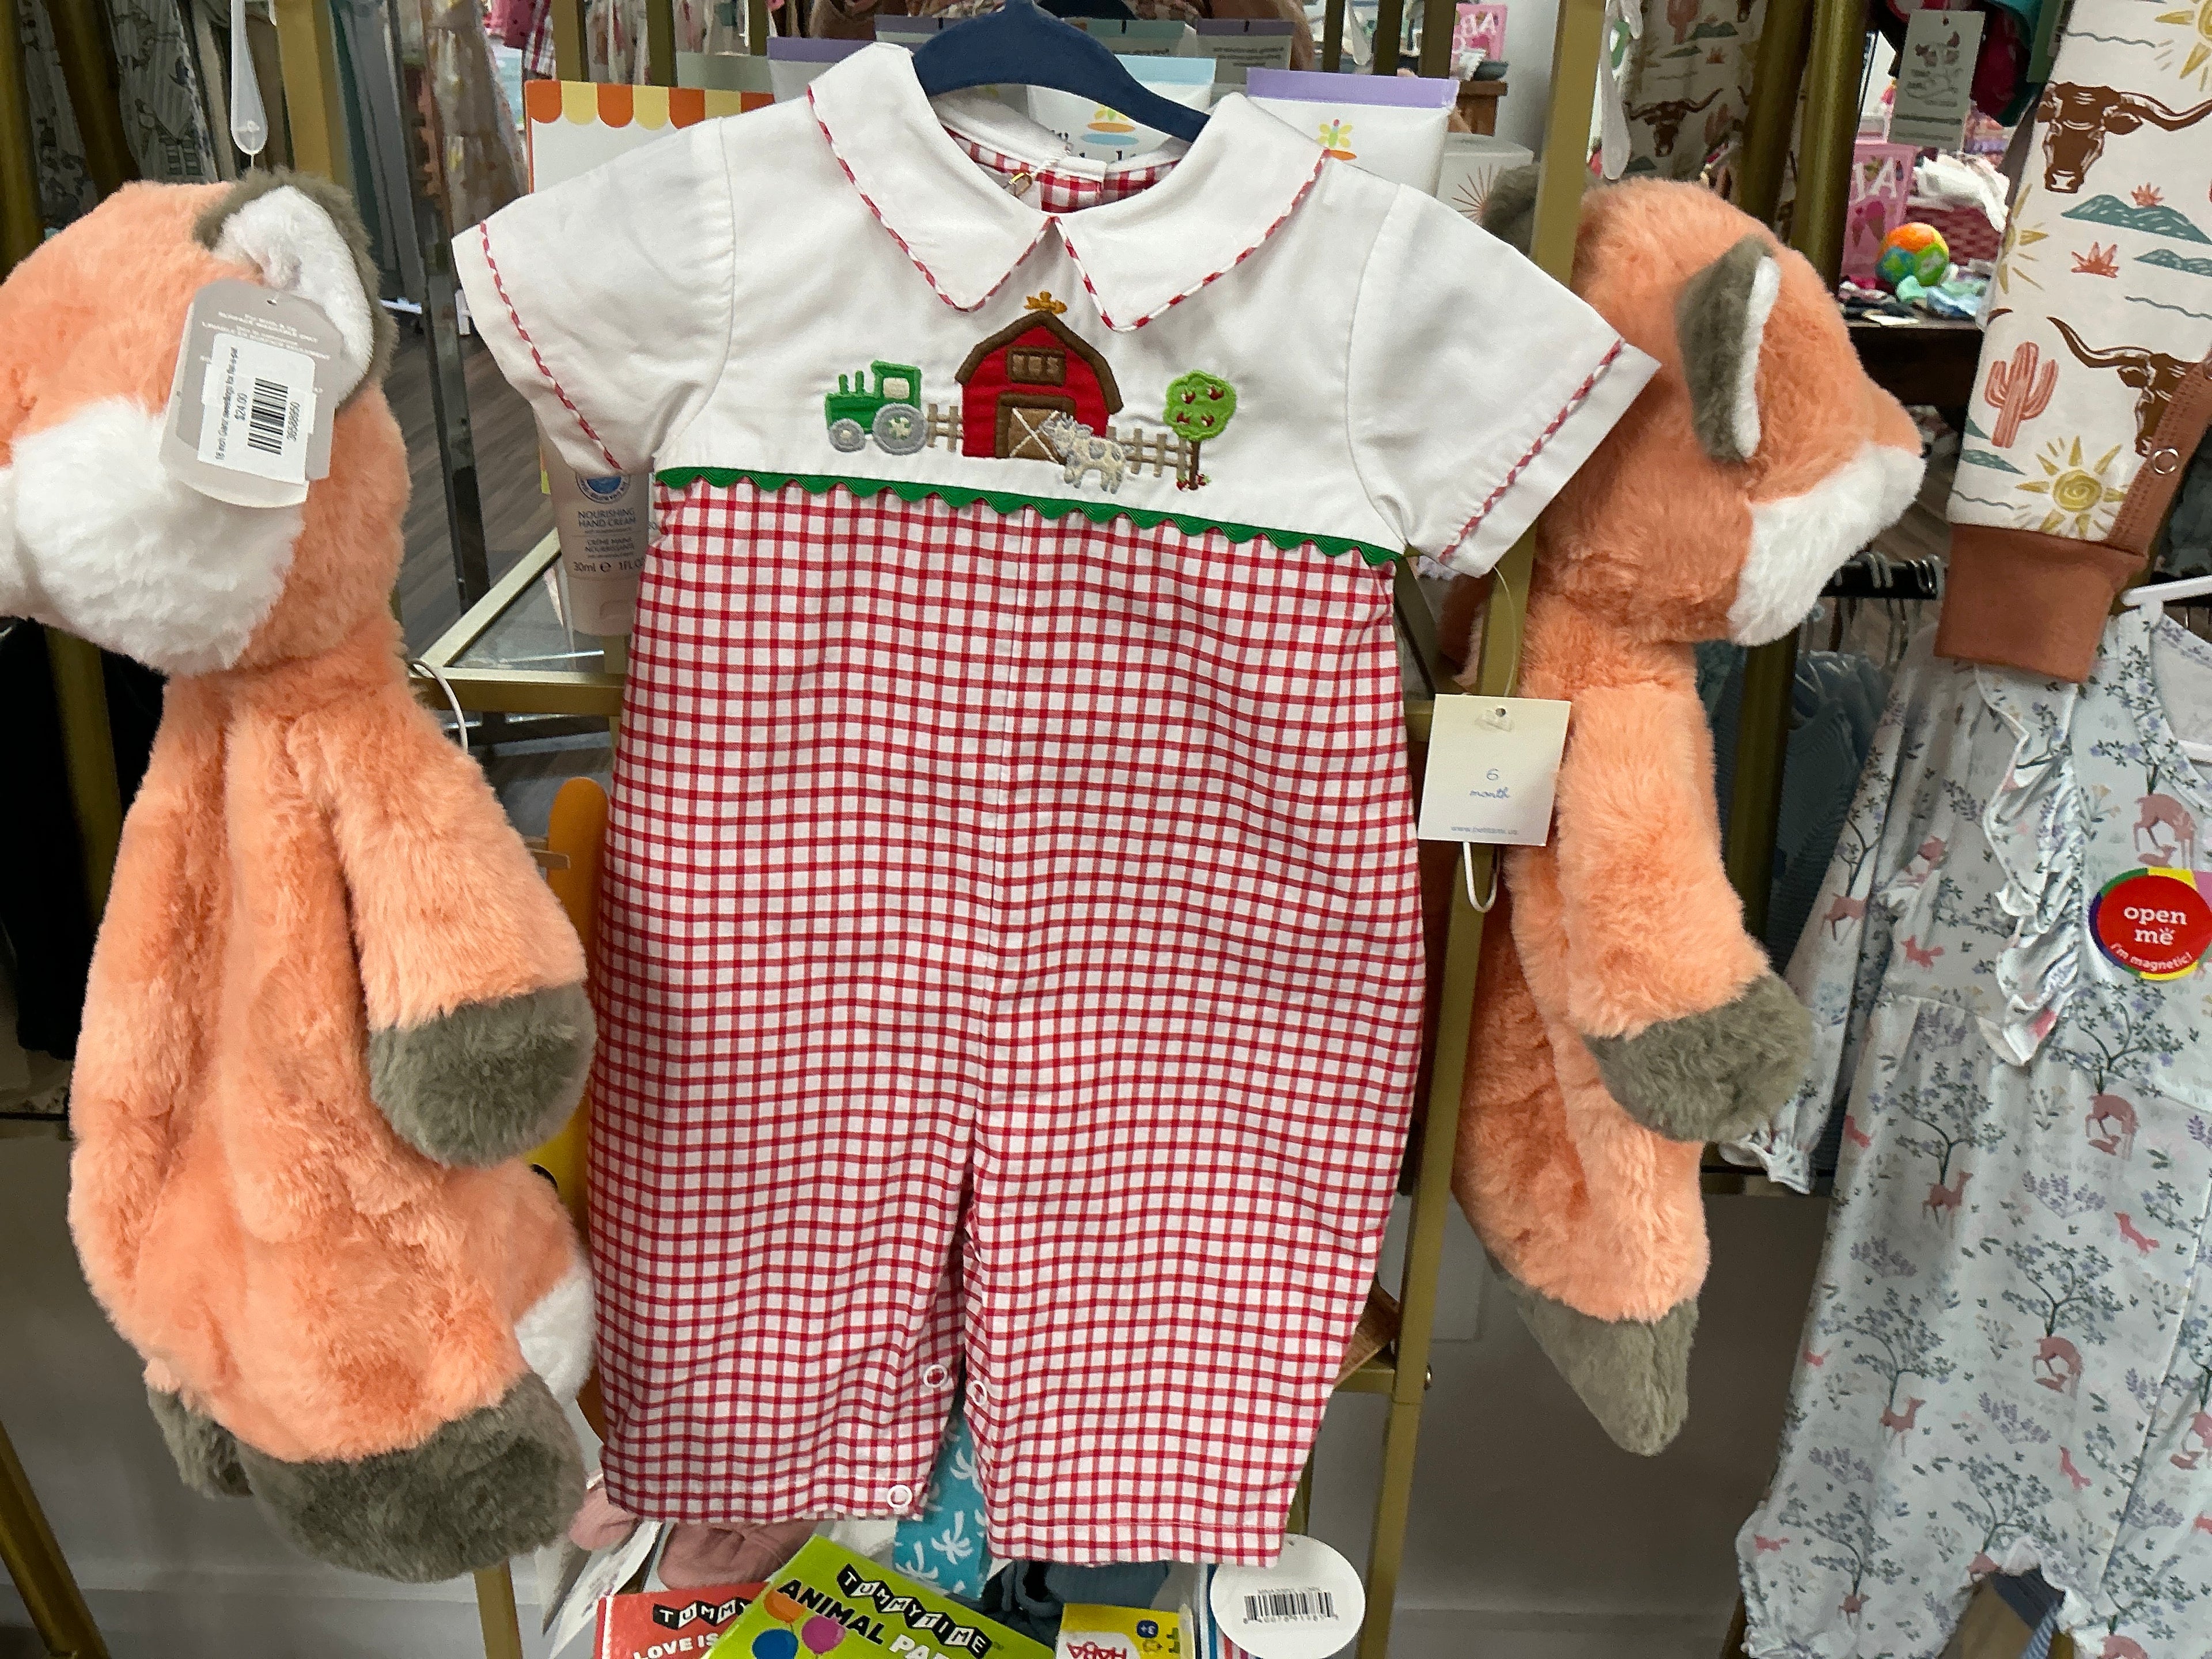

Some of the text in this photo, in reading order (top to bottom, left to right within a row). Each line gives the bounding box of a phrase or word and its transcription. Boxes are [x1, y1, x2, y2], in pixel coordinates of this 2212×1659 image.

[234, 393, 248, 421] $24.00
[578, 508, 635, 518] NOURISHING
[608, 517, 635, 526] CREAM
[1486, 768, 1499, 781] 6
[2123, 907, 2188, 925] open
[2110, 942, 2193, 971] I'm magnetic!
[777, 1579, 949, 1659] ANIMAL PA
[842, 1569, 989, 1654] TUMMYTIME
[634, 1637, 693, 1659] LOVE
